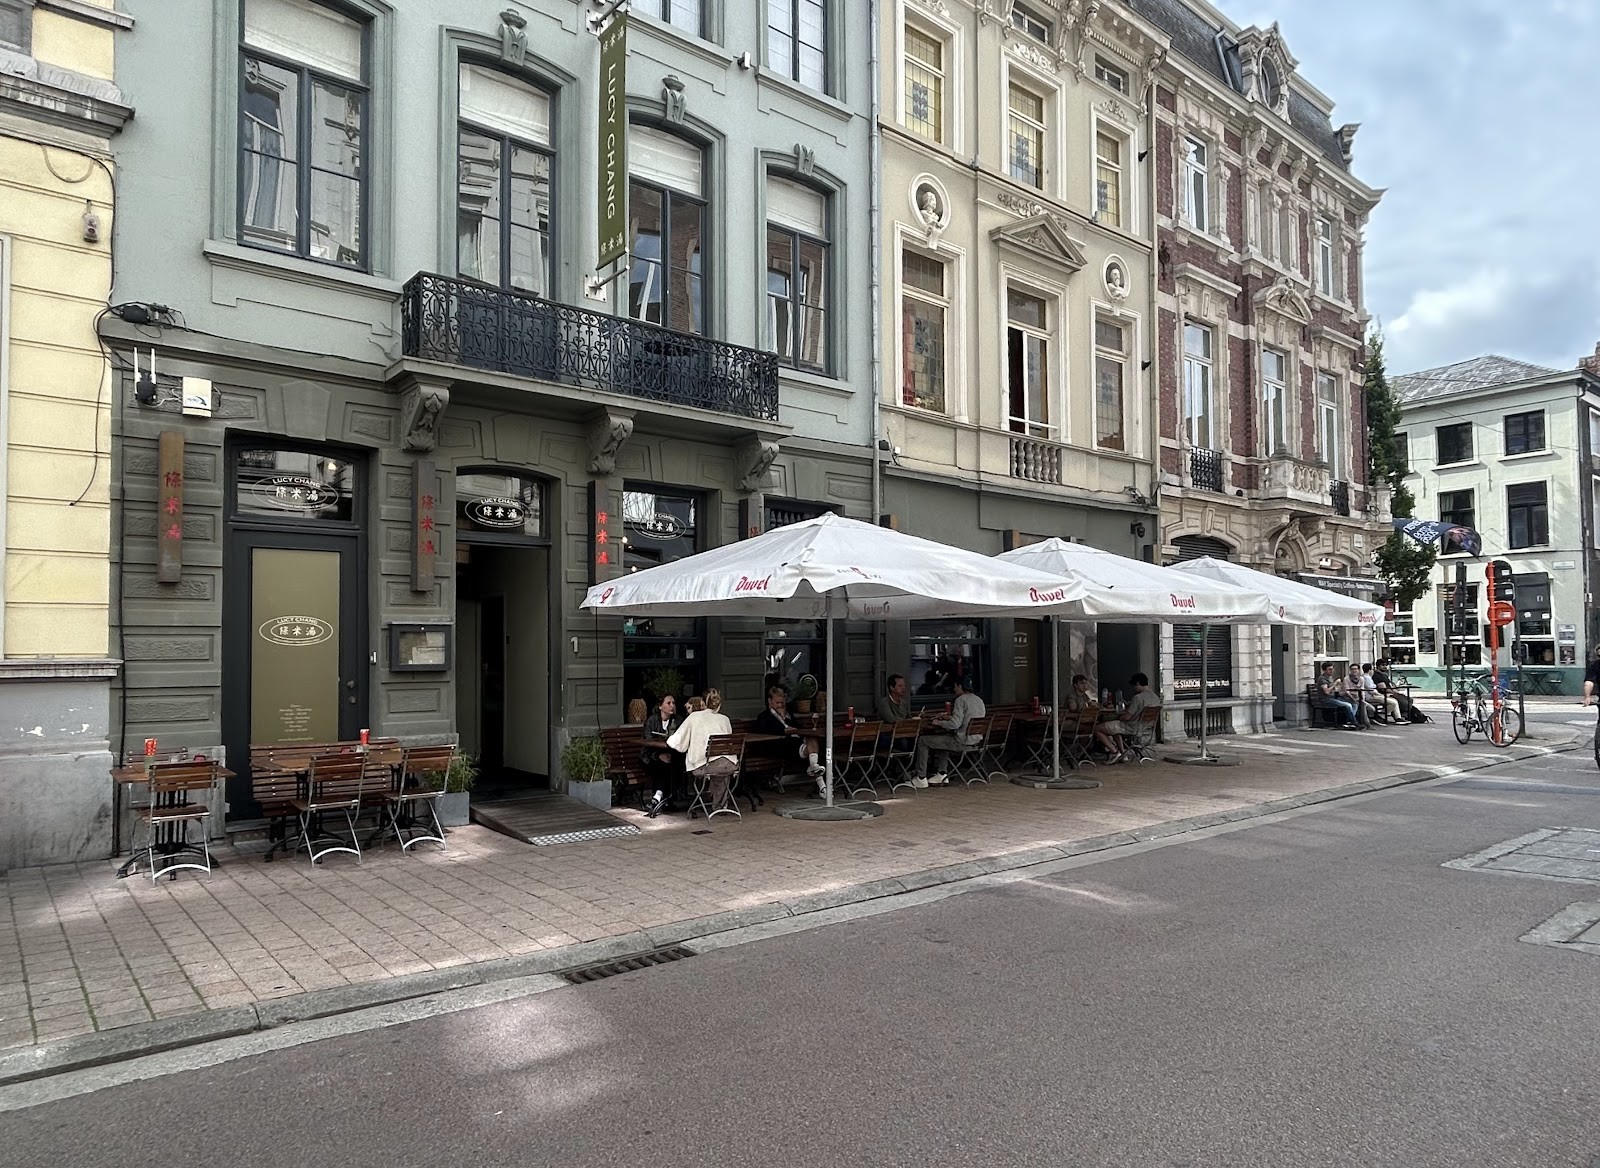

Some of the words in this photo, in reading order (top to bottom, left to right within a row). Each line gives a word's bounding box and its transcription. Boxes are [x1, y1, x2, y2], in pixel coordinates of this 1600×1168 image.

[607, 62, 616, 123] LUCY
[606, 133, 616, 219] CHANG
[294, 478, 321, 488] CHANG
[735, 574, 772, 592] Duvel
[1029, 587, 1066, 602] Duvel
[1170, 593, 1195, 608] Duvel
[570, 636, 579, 653] 1
